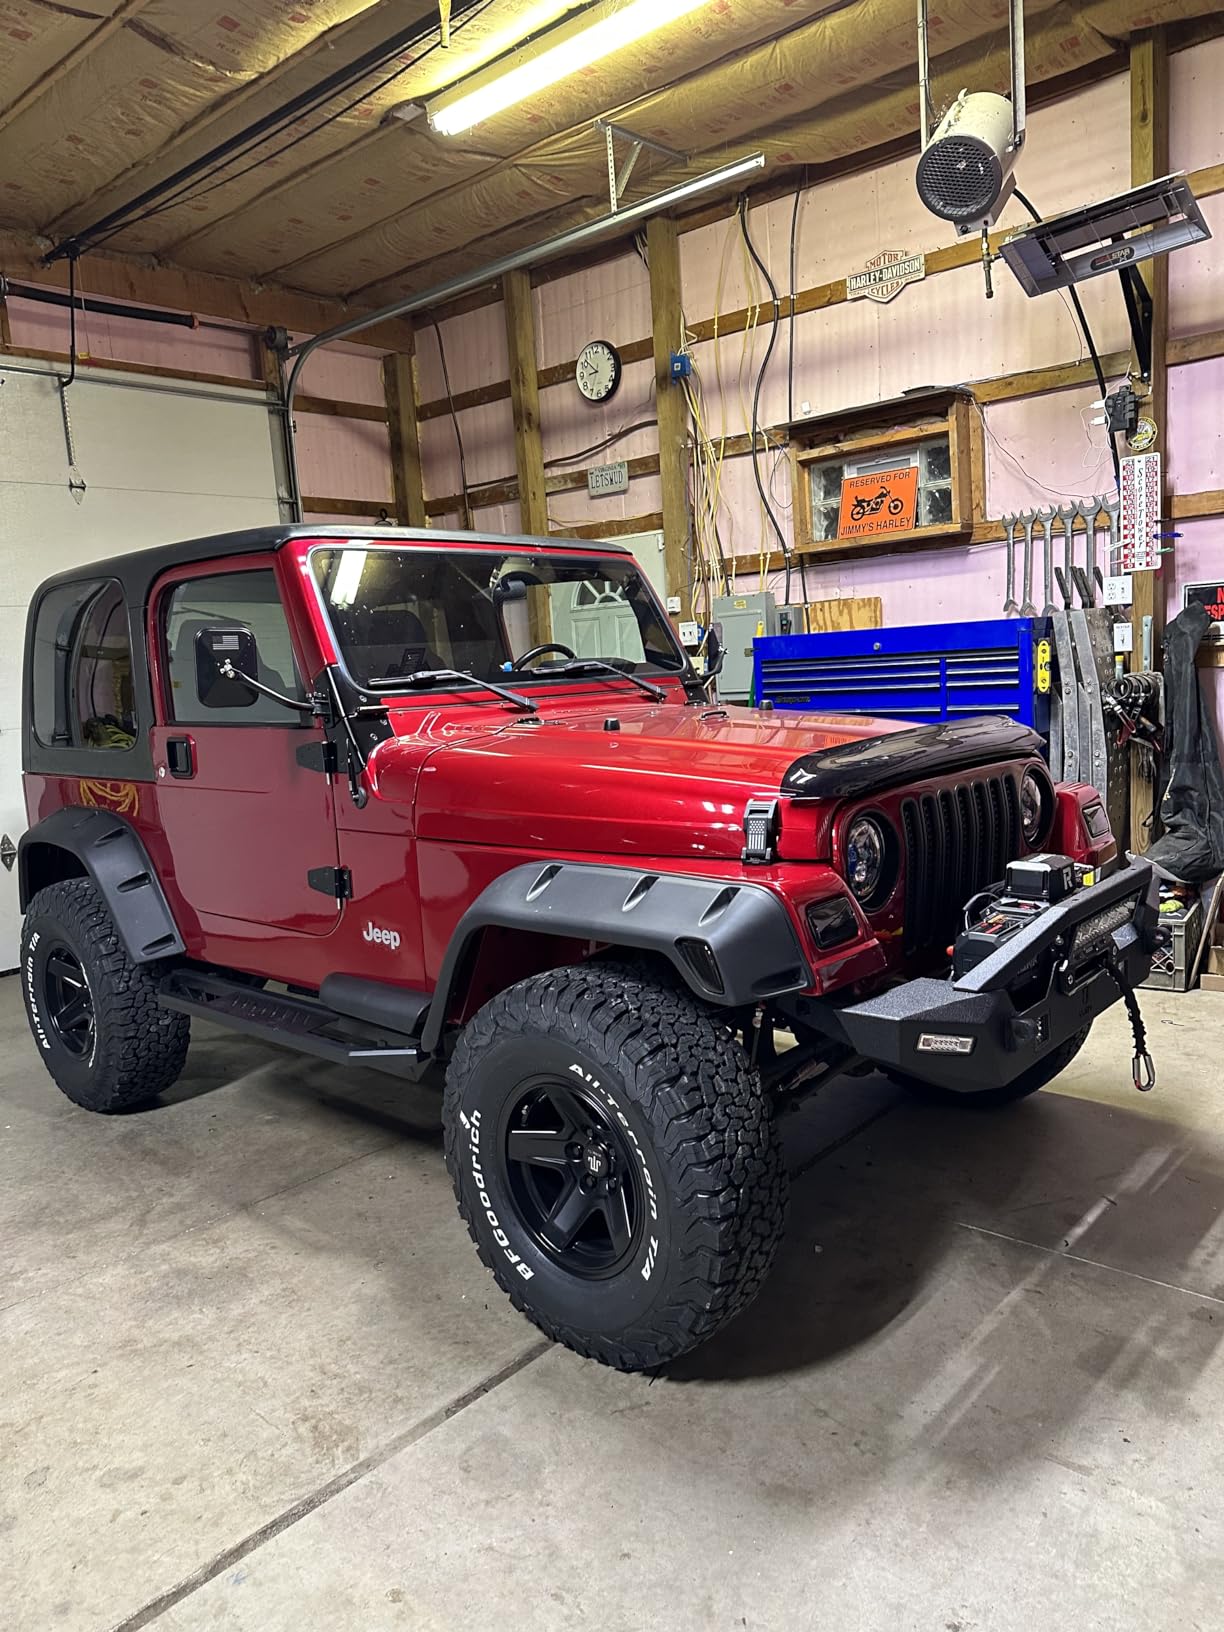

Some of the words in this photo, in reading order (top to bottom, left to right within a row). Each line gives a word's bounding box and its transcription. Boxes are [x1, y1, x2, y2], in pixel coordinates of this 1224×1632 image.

[869, 252, 899, 269] MOTOR
[850, 257, 920, 290] HARLEY-DAVIDSON
[870, 281, 900, 297] CYCLES
[591, 345, 599, 355] 12
[580, 371, 584, 381] 9
[583, 381, 588, 390] 8
[849, 475, 891, 488] RESERVED
[893, 471, 910, 481] FOR
[841, 521, 874, 536] JIMMY'S
[876, 516, 911, 531] HARLEY
[1062, 867, 1073, 890] R
[29, 932, 40, 952] T/A
[363, 921, 400, 950] Jeep
[26, 956, 51, 1049] All-Terrain
[569, 1063, 658, 1220] All-Terrain
[641, 1236, 659, 1281] T/A
[469, 1109, 535, 1281] BFGoodrich
